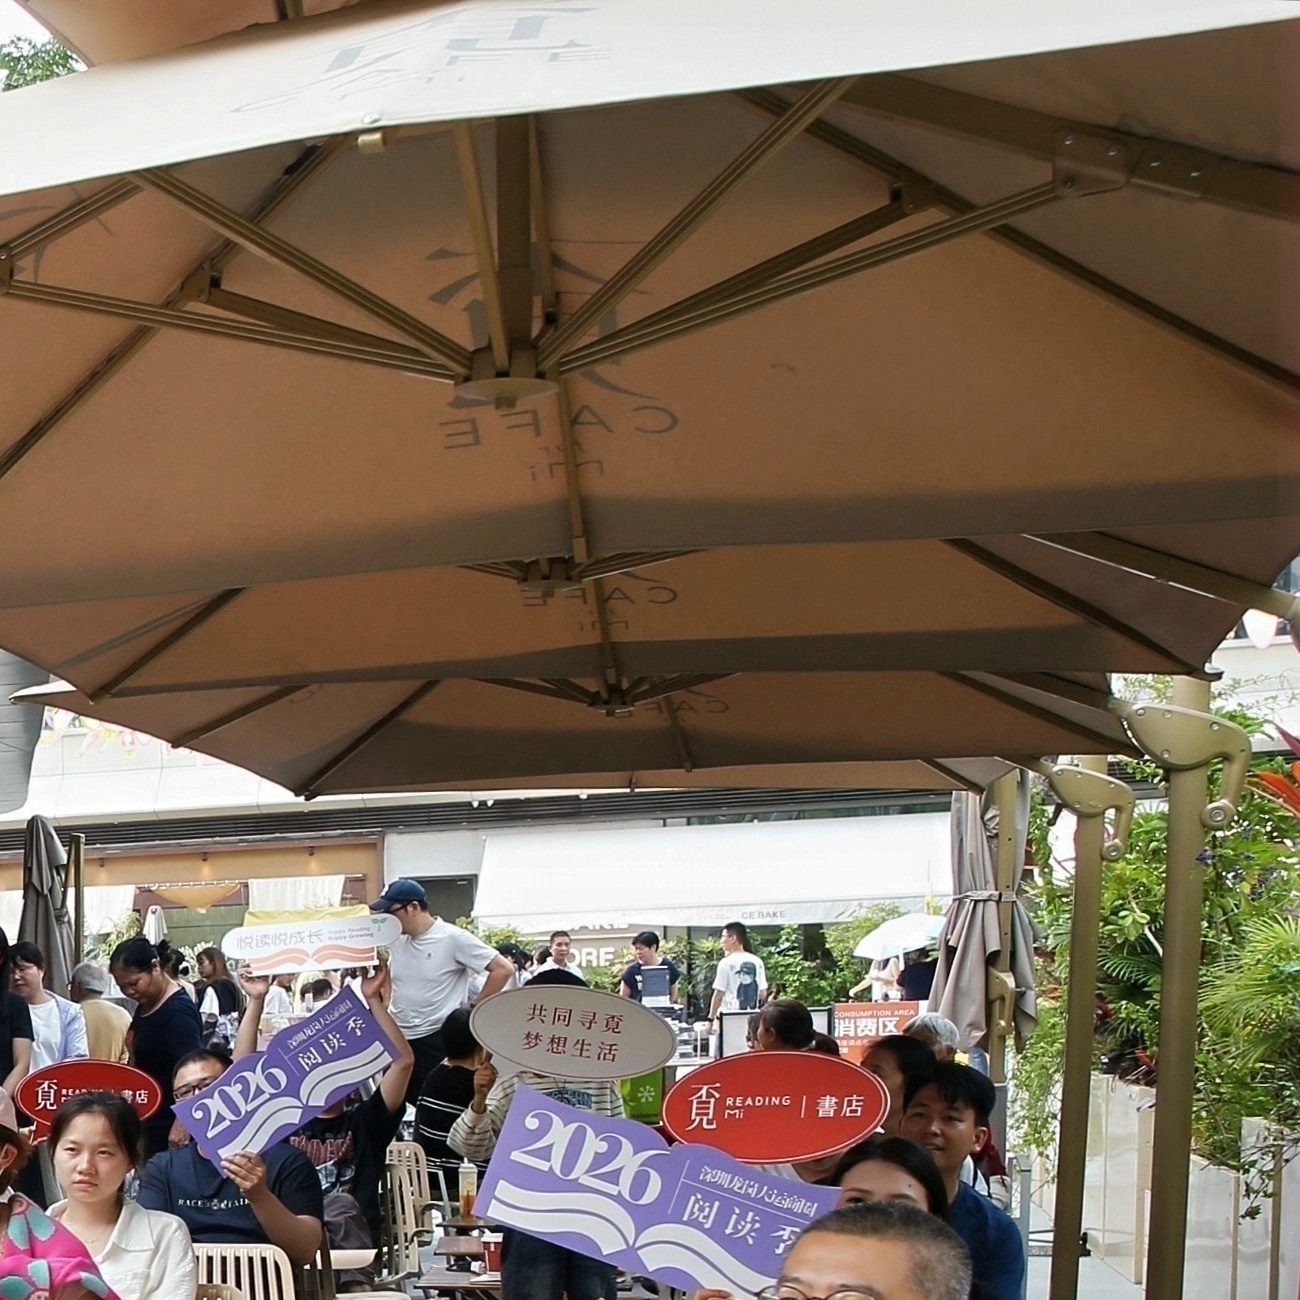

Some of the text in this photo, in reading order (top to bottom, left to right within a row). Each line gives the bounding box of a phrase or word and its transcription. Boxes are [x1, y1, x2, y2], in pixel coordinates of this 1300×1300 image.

[236, 928, 323, 950] 悦读悦成长
[834, 1010, 892, 1018] CONSUMPTION
[834, 1016, 904, 1038] 消费区
[297, 1015, 367, 1072] 阅读季
[521, 1030, 620, 1063] 梦想生活
[61, 1088, 104, 1096] READ
[191, 1054, 288, 1139] 2026
[725, 1095, 792, 1108] READING
[724, 1108, 745, 1120] Mi
[815, 1093, 865, 1119] 書店
[509, 1109, 672, 1206] 2026
[683, 1193, 801, 1256] 阅读季
